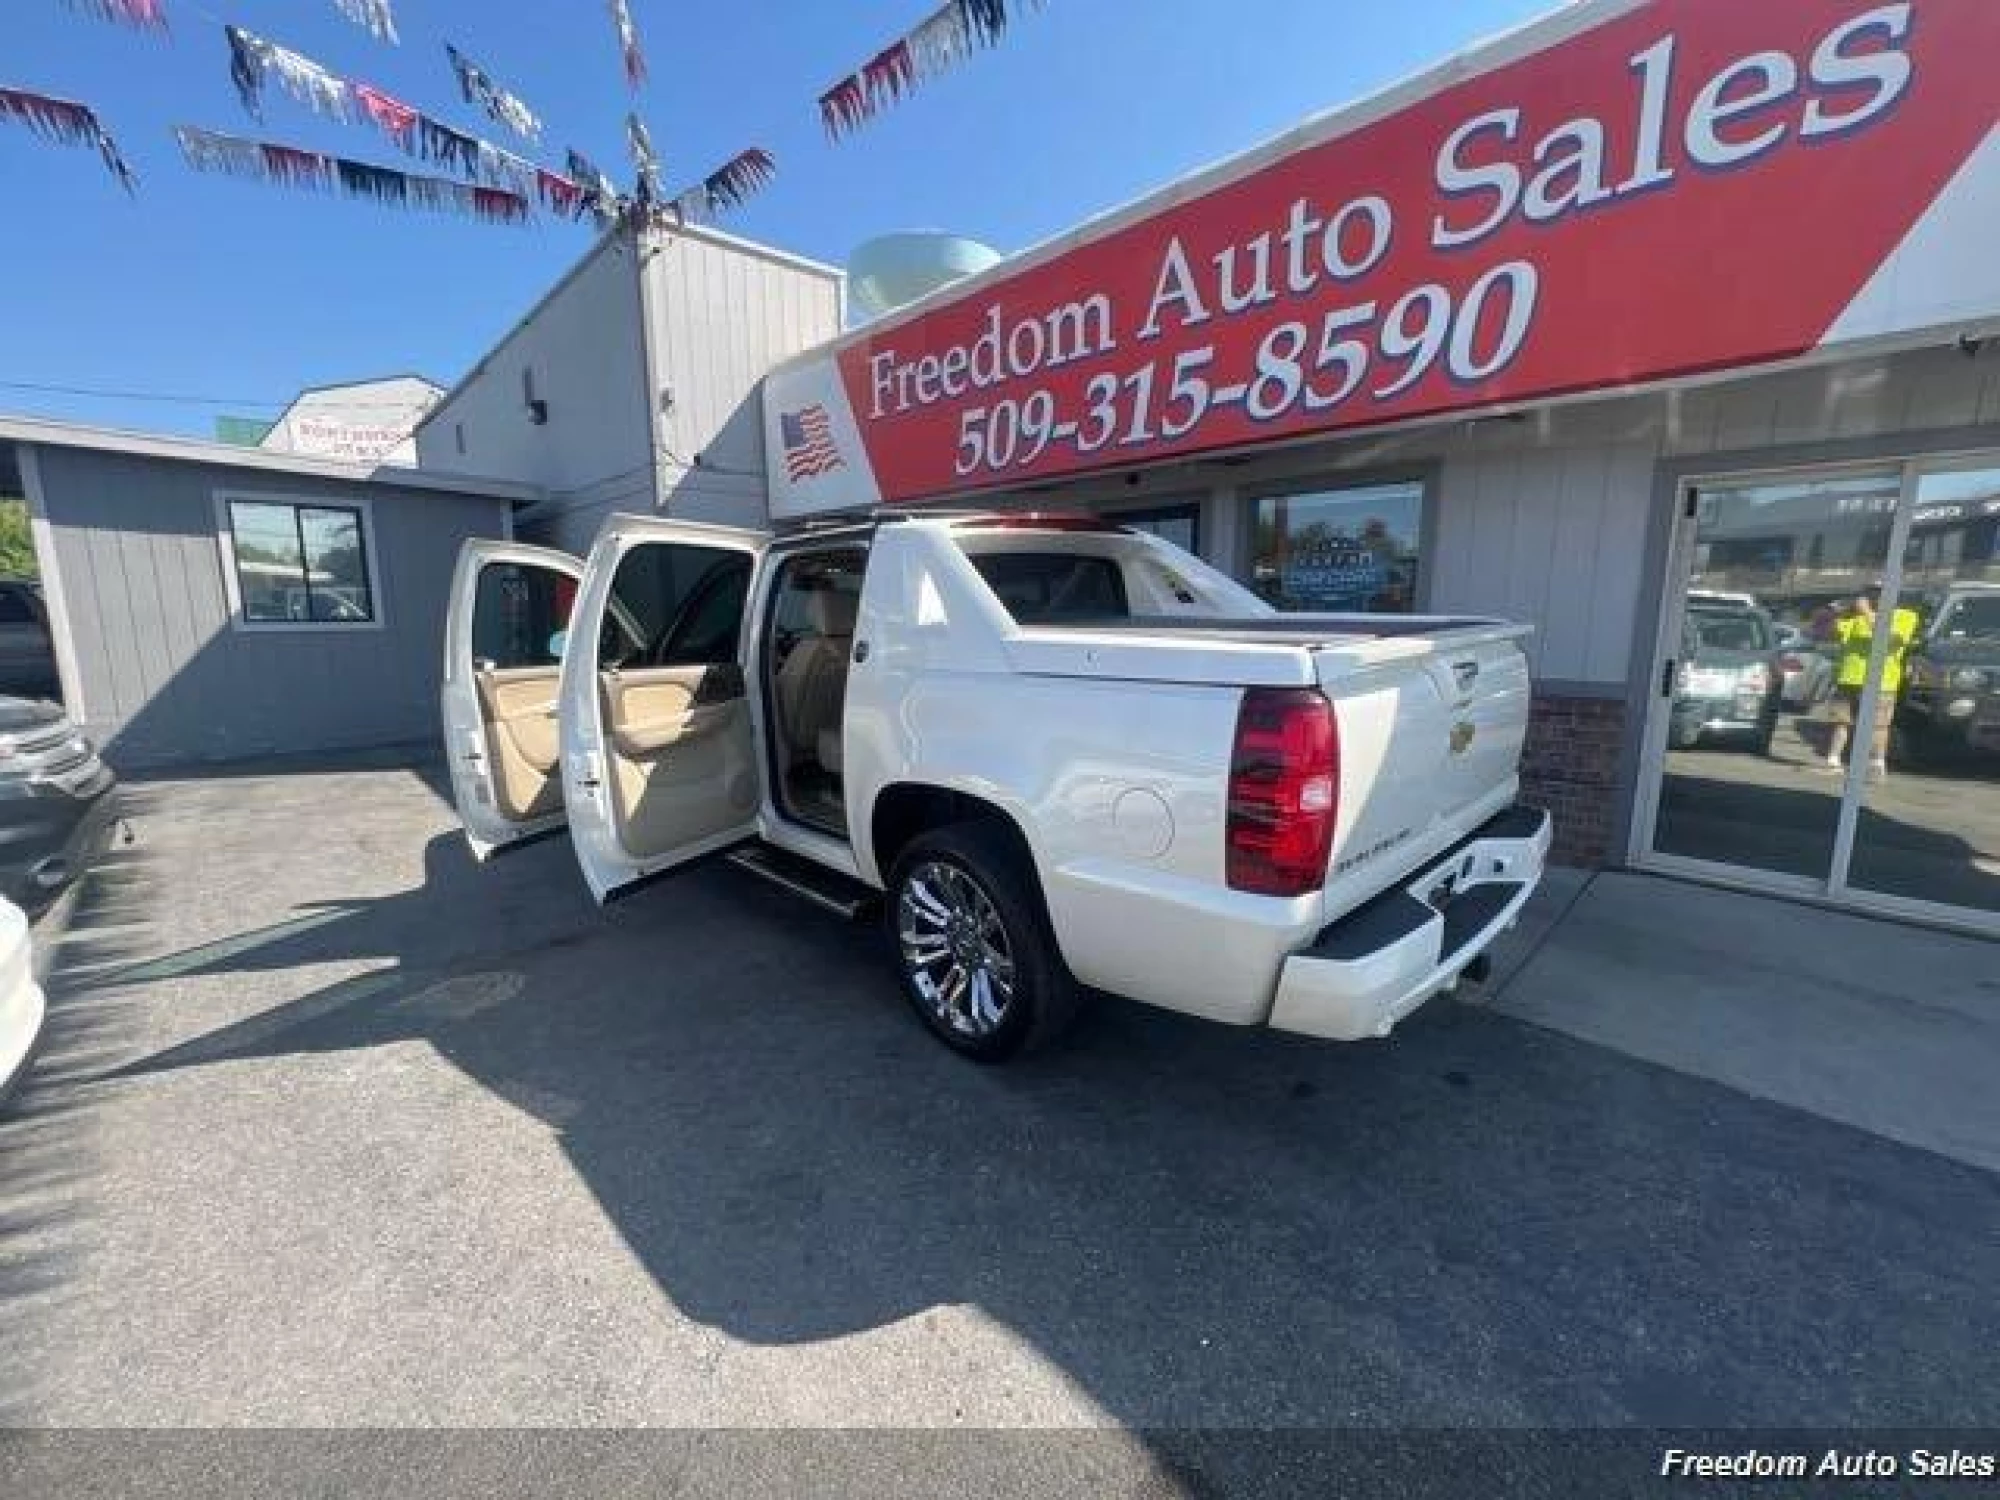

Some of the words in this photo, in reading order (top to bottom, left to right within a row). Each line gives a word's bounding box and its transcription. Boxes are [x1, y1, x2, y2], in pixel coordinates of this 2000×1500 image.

[867, 293, 1117, 421] Freedom
[1138, 195, 1393, 340] Auto
[1431, 3, 1913, 250] Sales
[954, 258, 1539, 477] 509-315-8590
